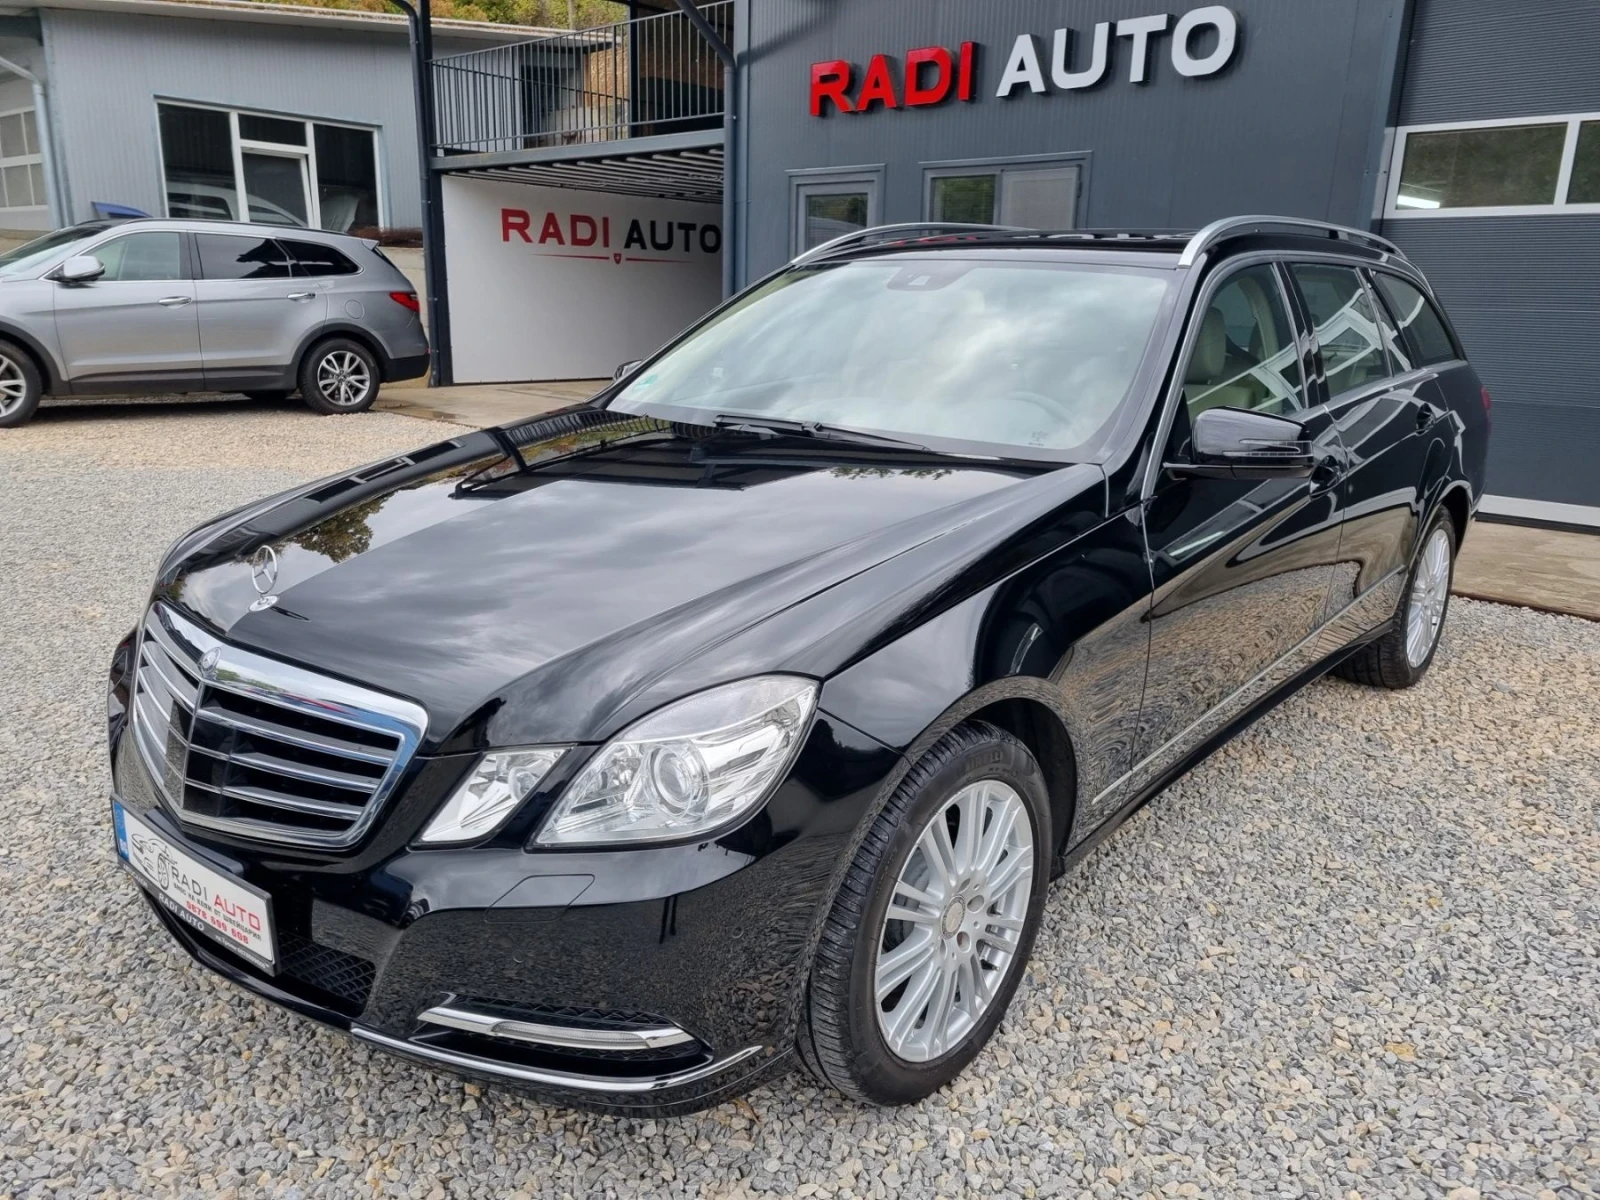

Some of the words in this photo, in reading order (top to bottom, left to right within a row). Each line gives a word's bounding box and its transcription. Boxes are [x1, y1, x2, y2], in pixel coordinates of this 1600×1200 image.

[810, 40, 976, 117] RADI
[996, 5, 1238, 97] AUTO
[501, 208, 610, 248] RADI
[623, 219, 722, 254] AUTO
[158, 892, 178, 913] RADI
[179, 908, 205, 932] AUTO
[171, 865, 208, 901] RADI
[214, 894, 261, 932] AUTO
